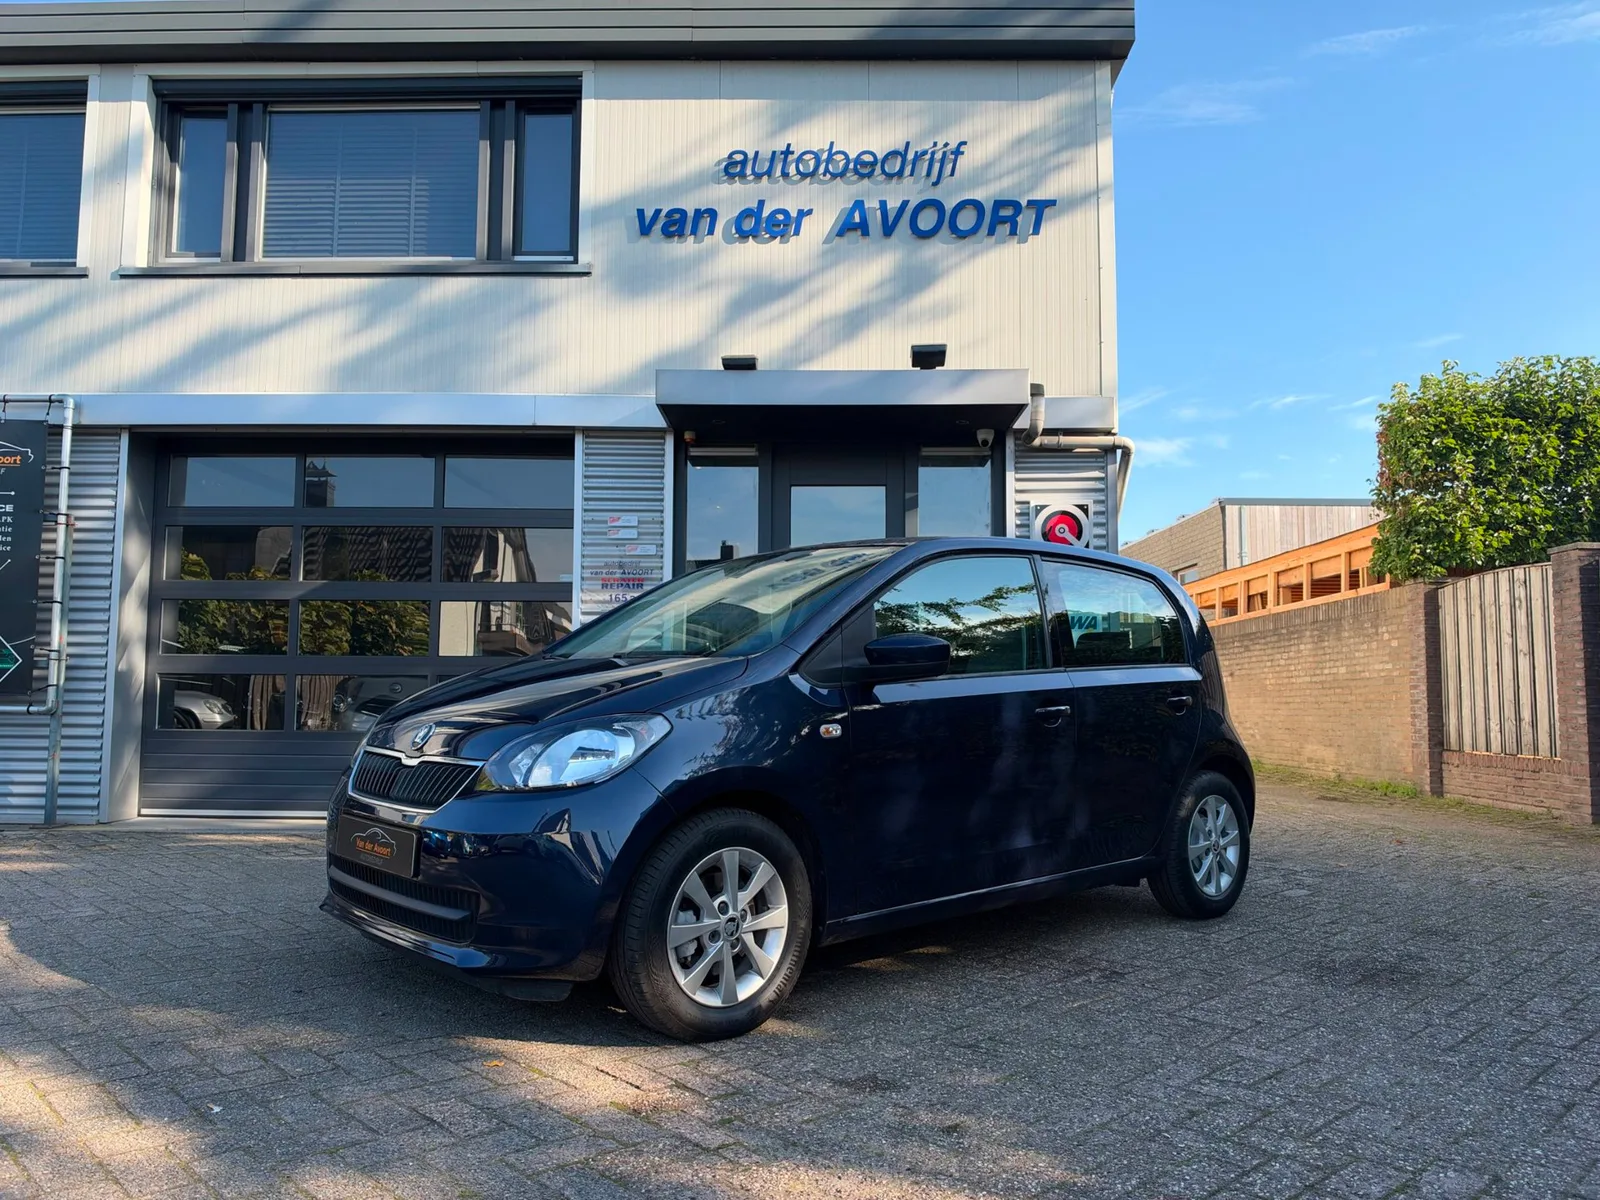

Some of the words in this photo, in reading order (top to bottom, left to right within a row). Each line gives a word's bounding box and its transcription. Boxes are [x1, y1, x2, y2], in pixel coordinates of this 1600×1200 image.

[723, 140, 967, 186] autobedrijf
[636, 207, 718, 237] van
[734, 199, 813, 238] der
[836, 198, 1057, 239] AVOORT
